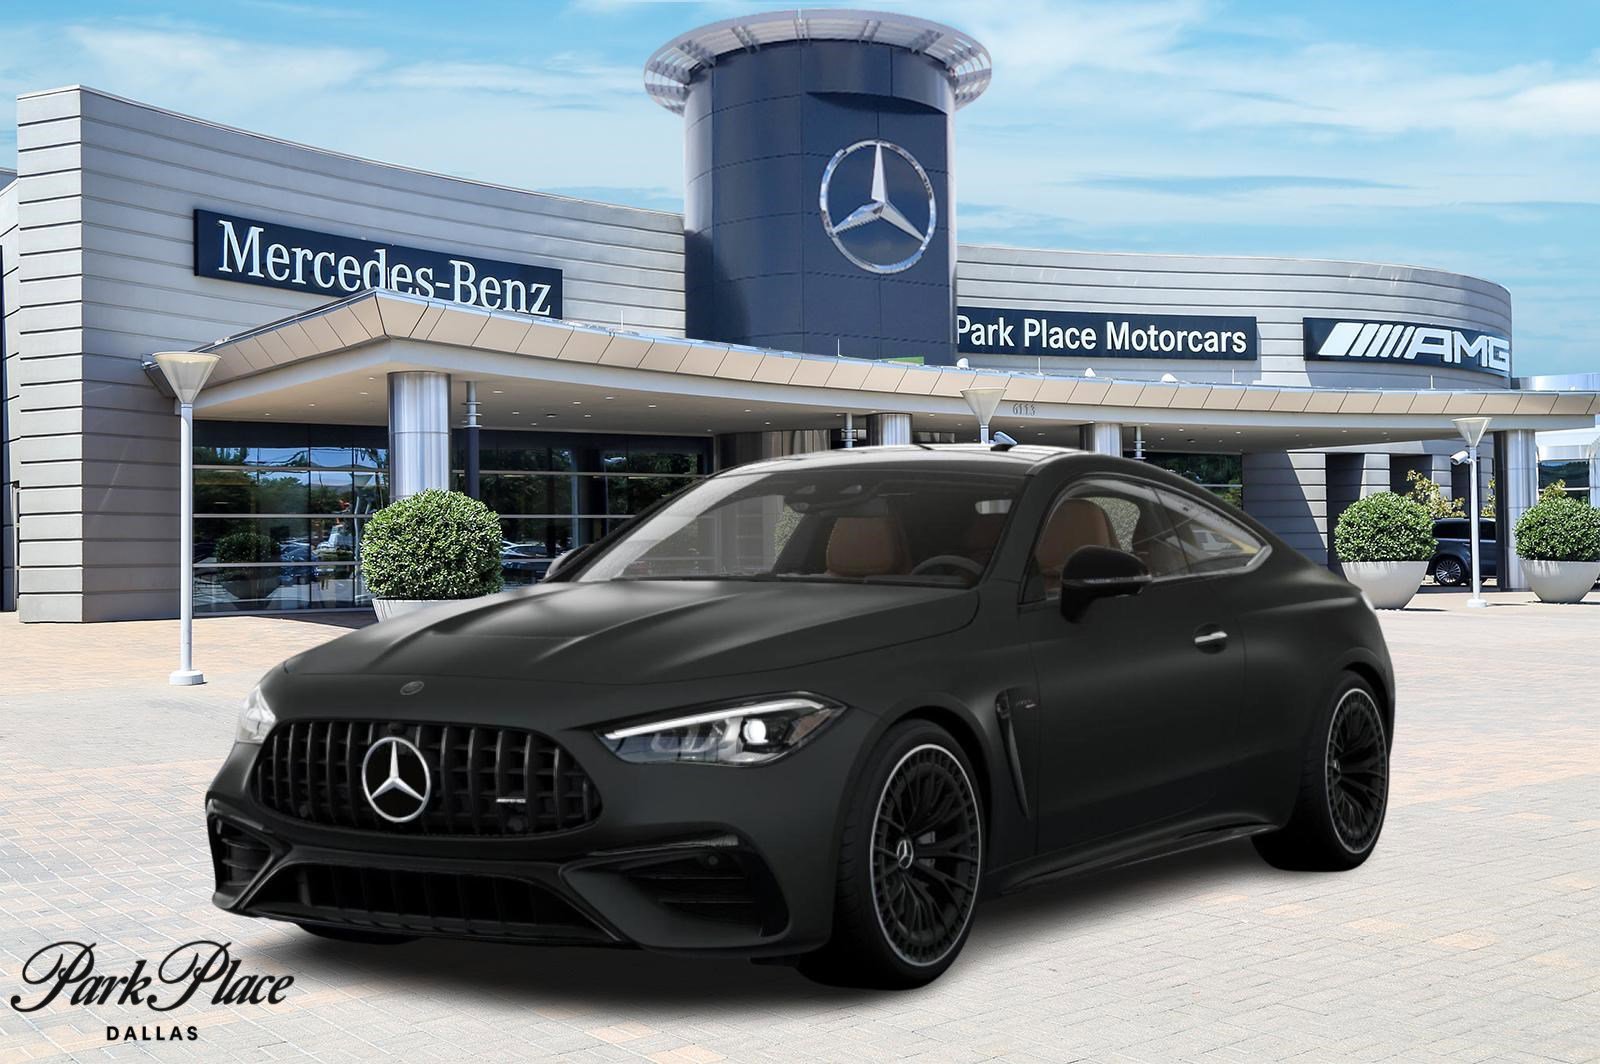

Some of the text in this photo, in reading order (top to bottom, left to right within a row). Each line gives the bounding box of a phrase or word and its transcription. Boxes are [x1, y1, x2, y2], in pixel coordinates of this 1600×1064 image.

[217, 219, 552, 316] Mercedes-Benz
[956, 315, 1248, 353] Park Place Motorcars
[1012, 403, 1036, 416] 6113
